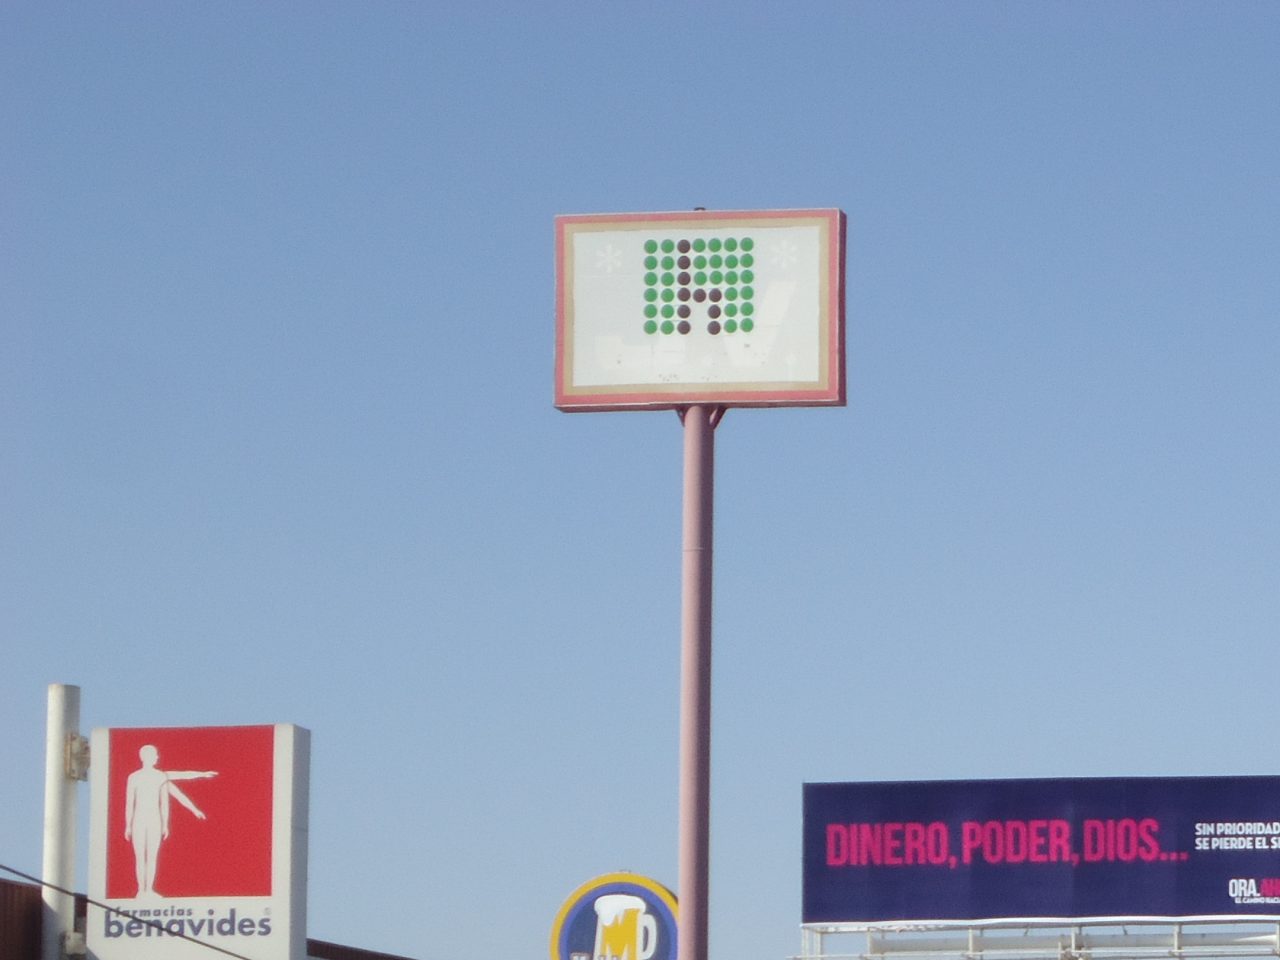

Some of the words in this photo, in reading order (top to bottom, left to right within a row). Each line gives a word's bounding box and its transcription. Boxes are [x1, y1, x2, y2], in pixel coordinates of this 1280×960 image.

[1195, 822, 1214, 836] SIN
[825, 821, 958, 869] DINERO,
[961, 818, 1081, 866] PODER,
[1083, 818, 1190, 863] DIOS...
[1195, 837, 1210, 850] SE
[1211, 837, 1254, 850] PIERDE
[1255, 836, 1270, 849] EL
[114, 905, 193, 917] farmacias
[104, 908, 272, 938] benavides
